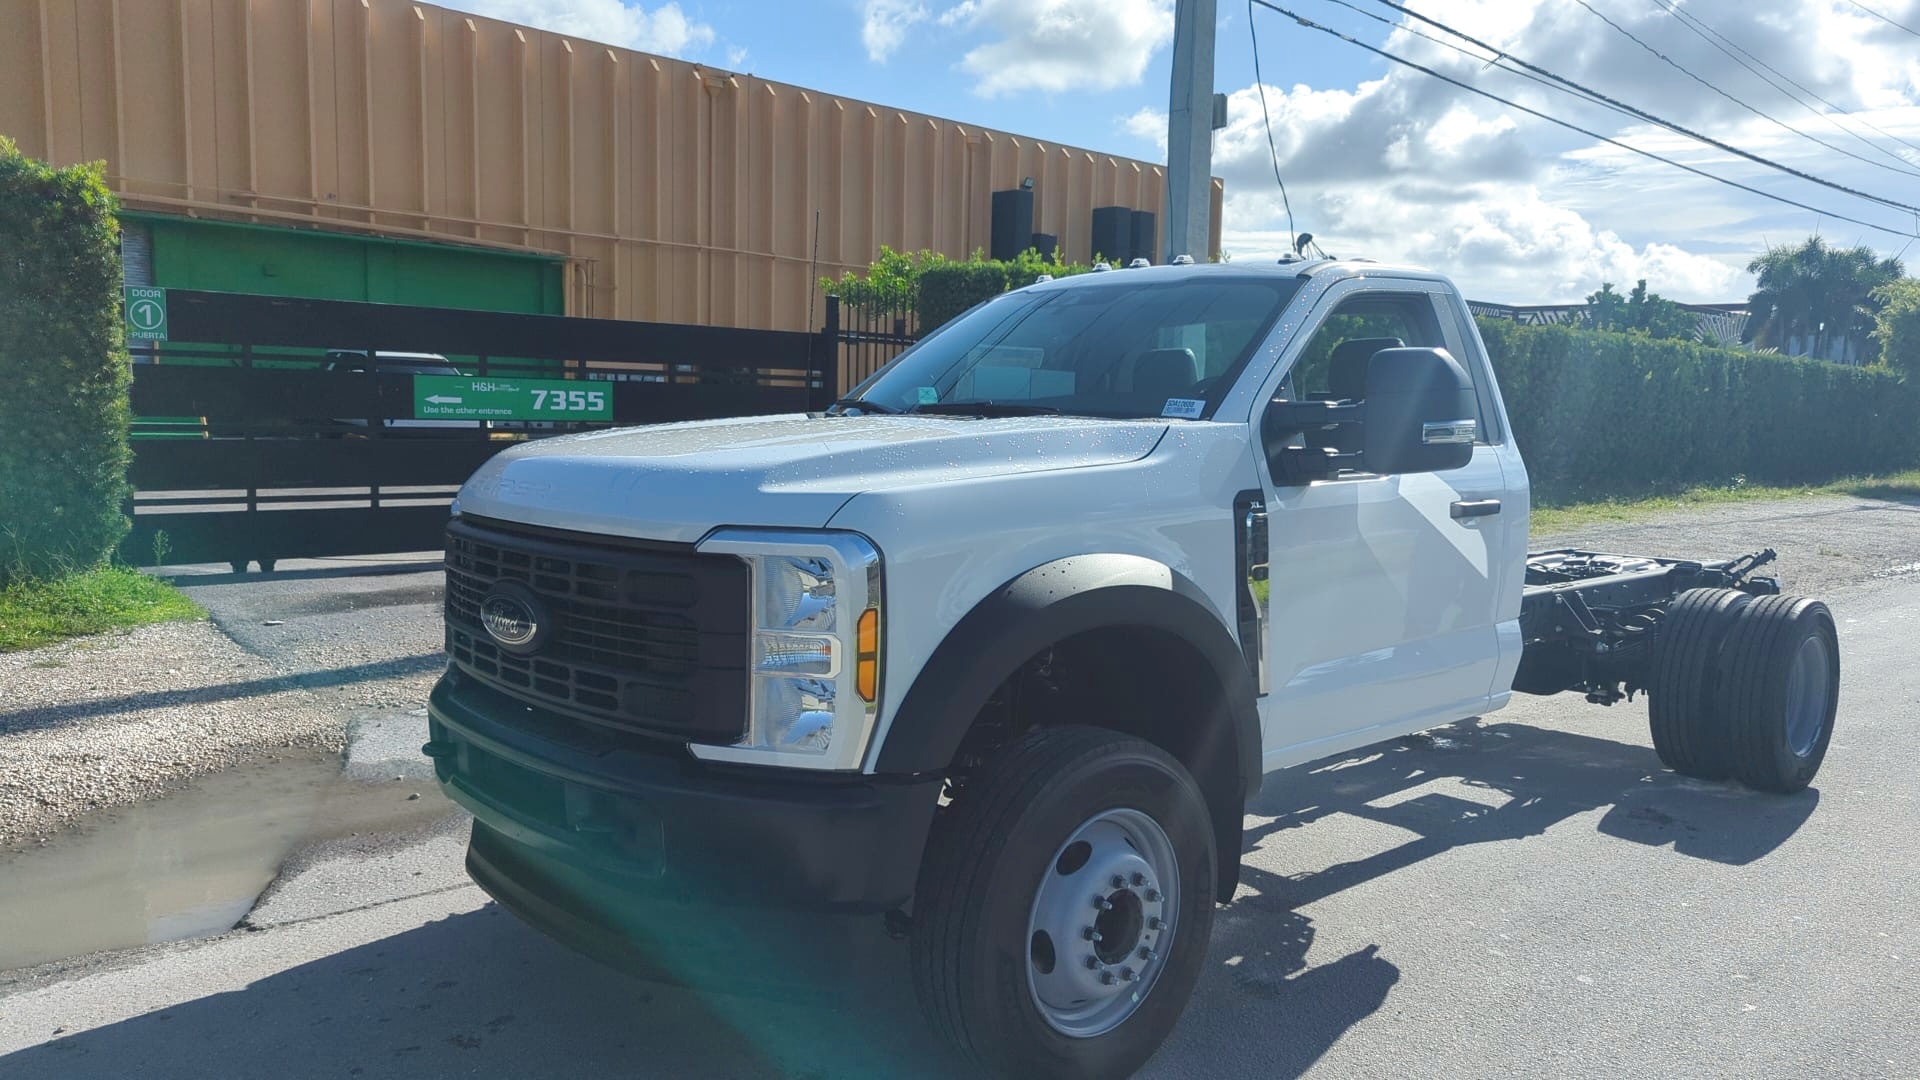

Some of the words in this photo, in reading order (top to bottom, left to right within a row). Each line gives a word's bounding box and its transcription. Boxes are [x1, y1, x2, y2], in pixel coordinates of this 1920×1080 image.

[132, 289, 160, 298] DOOR
[139, 304, 151, 326] 1
[132, 331, 165, 339] PUERTA
[472, 382, 495, 392] H&H
[530, 389, 604, 411] 7355
[423, 406, 439, 414] Use
[440, 406, 454, 414] the
[455, 407, 477, 415] other
[478, 408, 512, 416] entrance
[1250, 501, 1264, 509] XL
[487, 602, 520, 634] Ford
